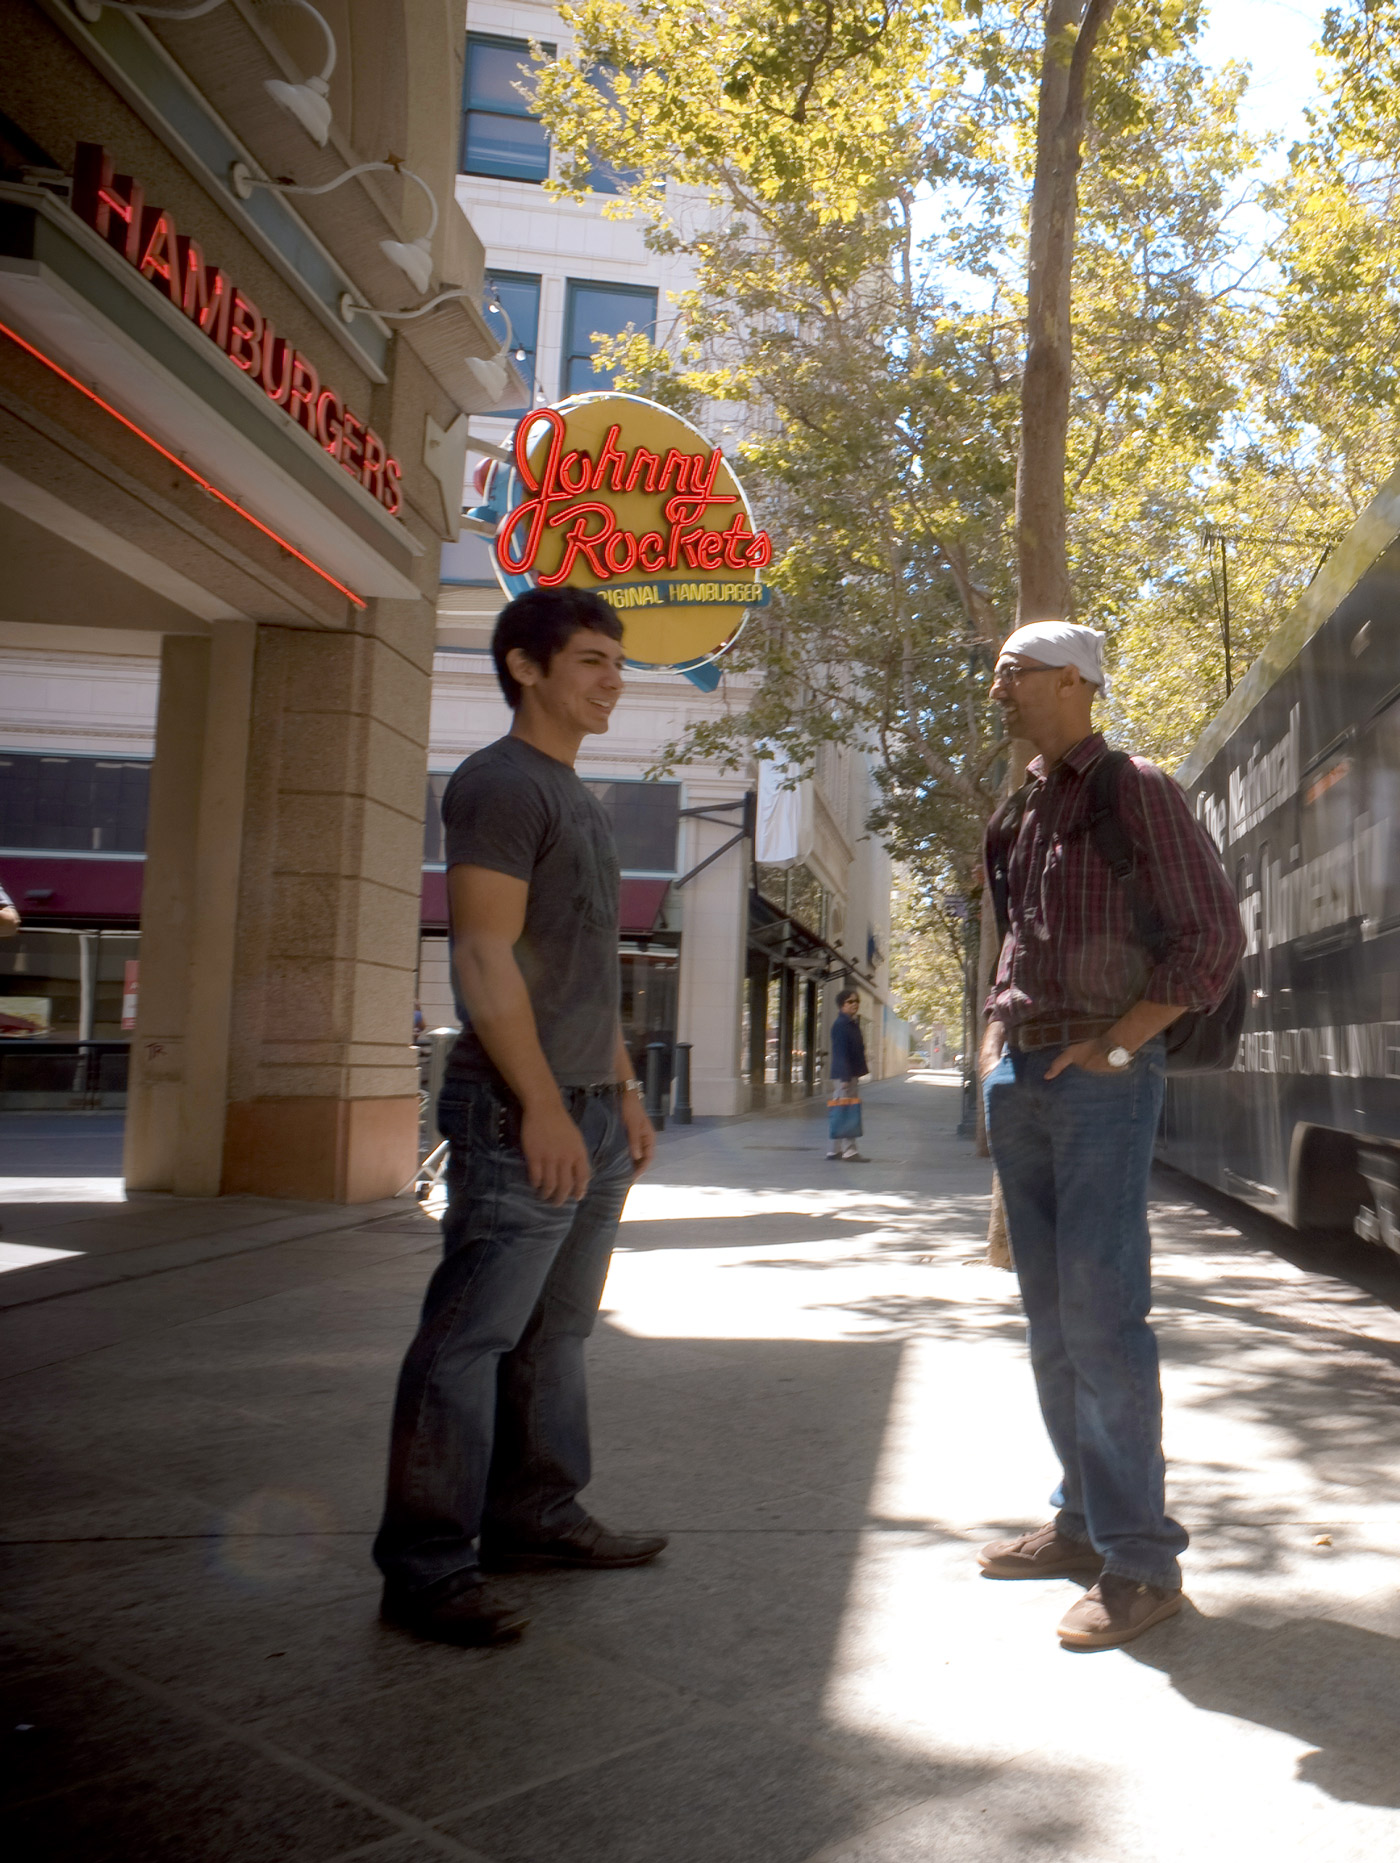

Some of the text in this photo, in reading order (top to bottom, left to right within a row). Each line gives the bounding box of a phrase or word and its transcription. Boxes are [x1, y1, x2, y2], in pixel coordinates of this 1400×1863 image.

[74, 141, 402, 516] HAMBURGERS
[497, 408, 737, 576] Johnny
[537, 502, 773, 587] Rockets
[668, 583, 764, 603] HAMBURGER
